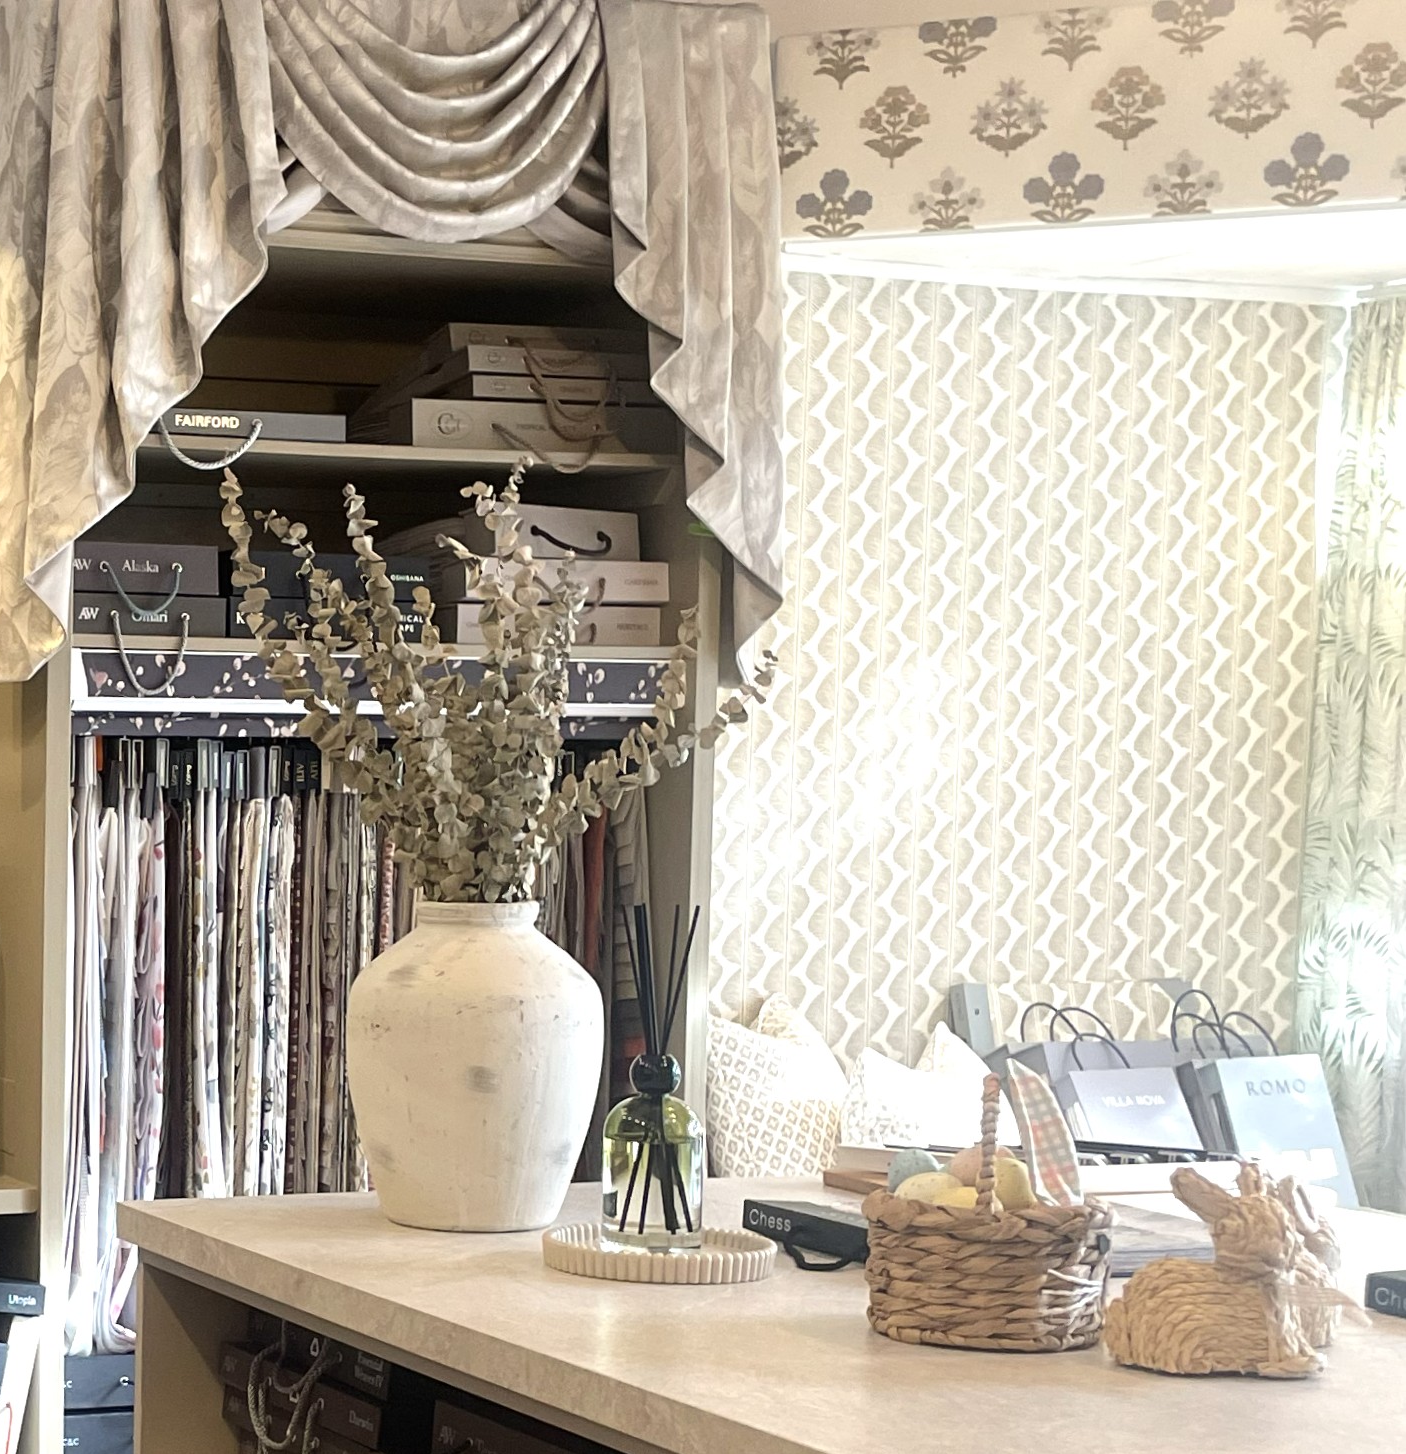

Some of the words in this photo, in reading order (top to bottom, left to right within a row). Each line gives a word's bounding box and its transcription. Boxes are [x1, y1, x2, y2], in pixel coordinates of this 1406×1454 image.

[174, 414, 241, 430] FAIRFORD
[121, 559, 160, 574] Alaska
[78, 607, 100, 621] AW
[1245, 1078, 1306, 1098] ROMO
[1101, 1094, 1134, 1108] VILLA
[1135, 1093, 1166, 1107] NOVA
[748, 1208, 792, 1233] Chess
[1374, 1286, 1406, 1311] Ch
